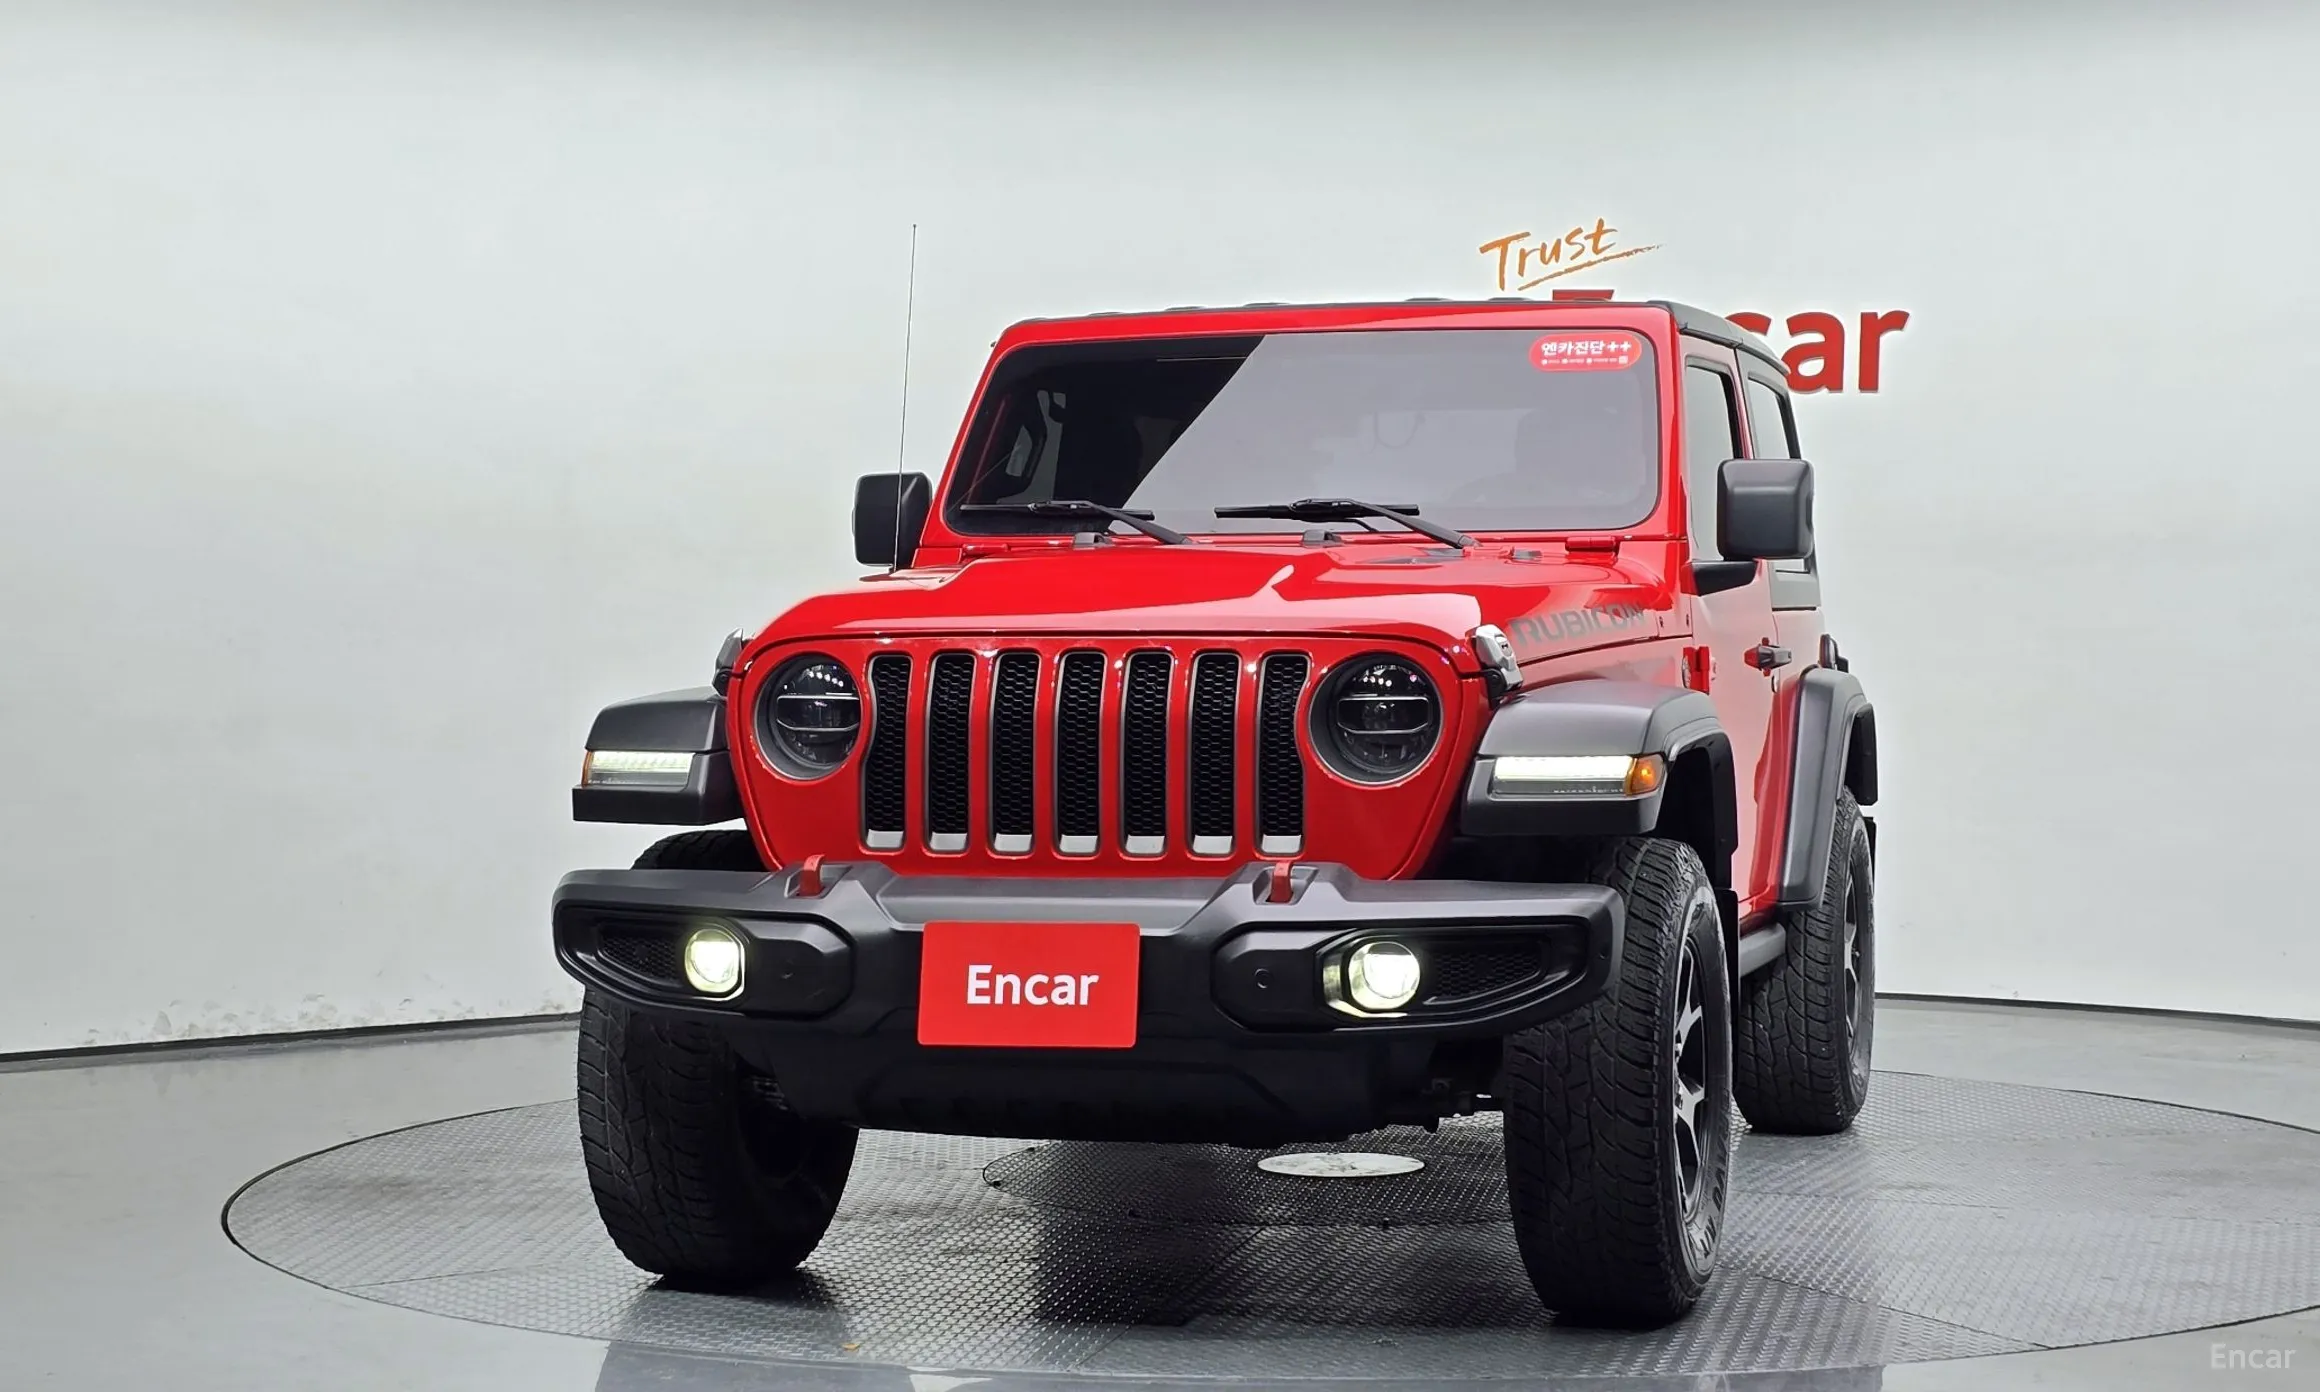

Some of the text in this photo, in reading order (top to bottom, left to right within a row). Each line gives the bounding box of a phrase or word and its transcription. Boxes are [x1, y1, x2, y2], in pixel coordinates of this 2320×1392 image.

[1479, 218, 1618, 291] Trust
[1509, 603, 1644, 646] RUBICON
[966, 964, 1099, 1005] Encar
